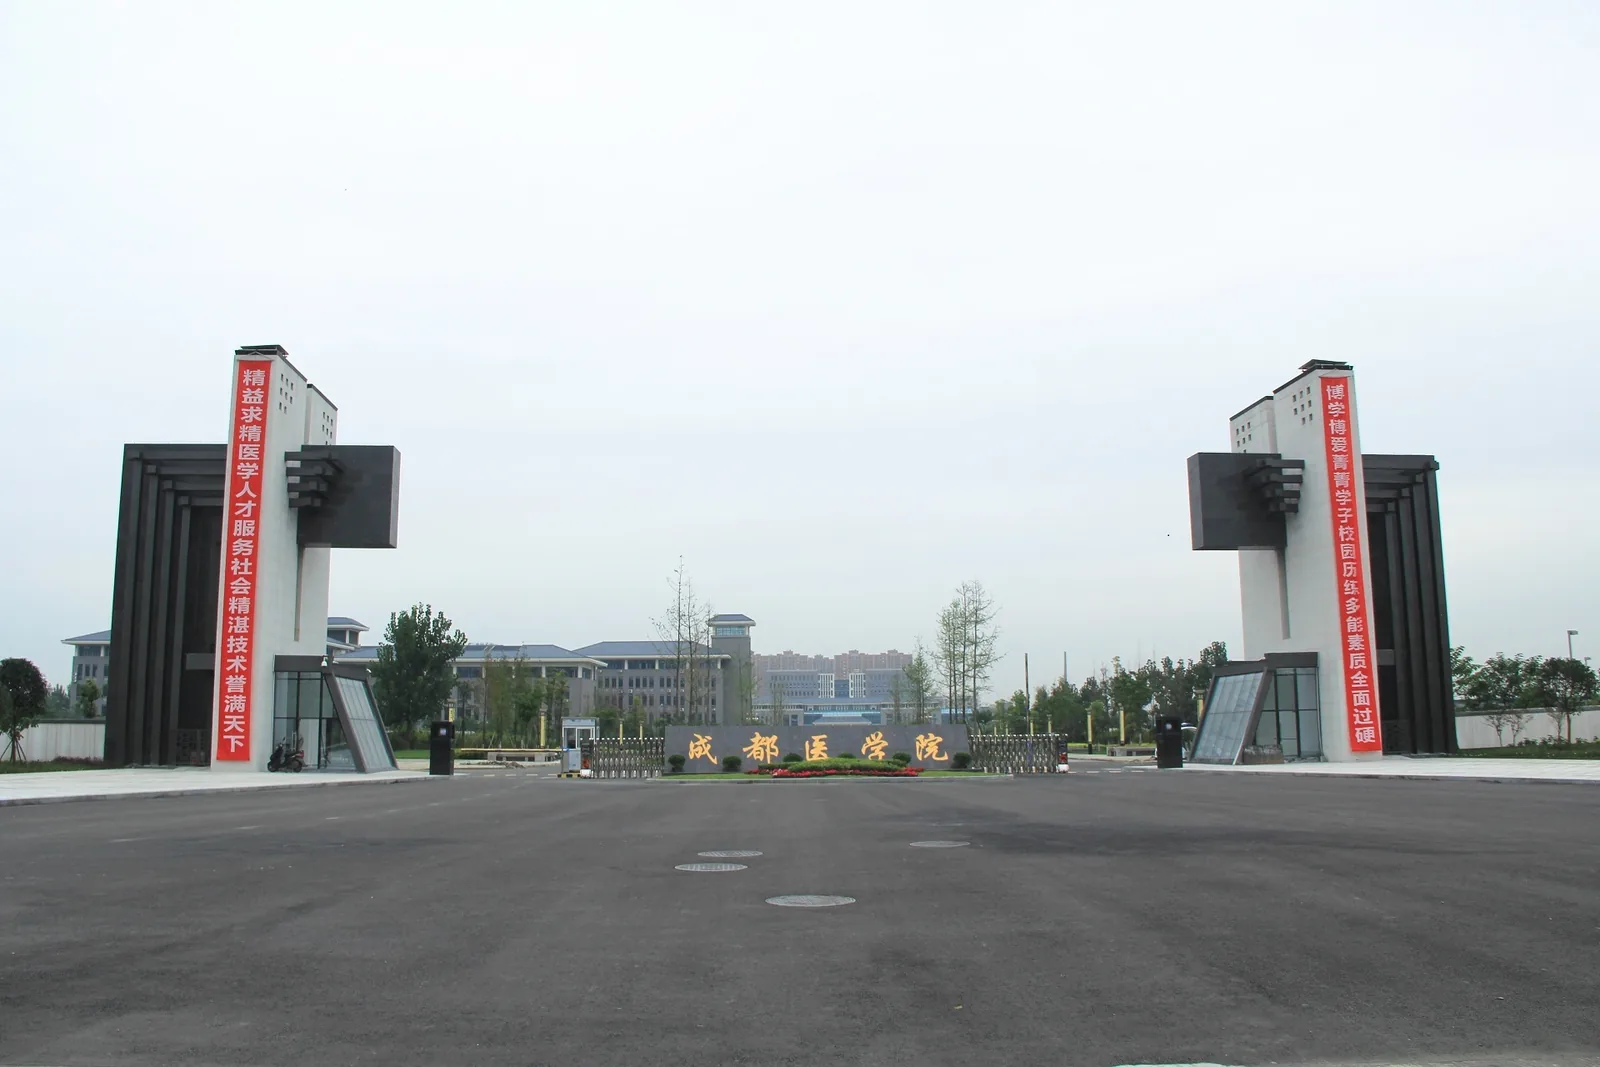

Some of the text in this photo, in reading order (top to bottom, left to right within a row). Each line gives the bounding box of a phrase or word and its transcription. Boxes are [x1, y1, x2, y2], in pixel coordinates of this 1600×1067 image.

[223, 369, 266, 753] 精益求精医学人才服务社会精湛技术誉满天下
[1326, 384, 1376, 744] 博学博爱菁菁学子校园历练多能素质全面过硬
[688, 731, 947, 764] 成都医学院
